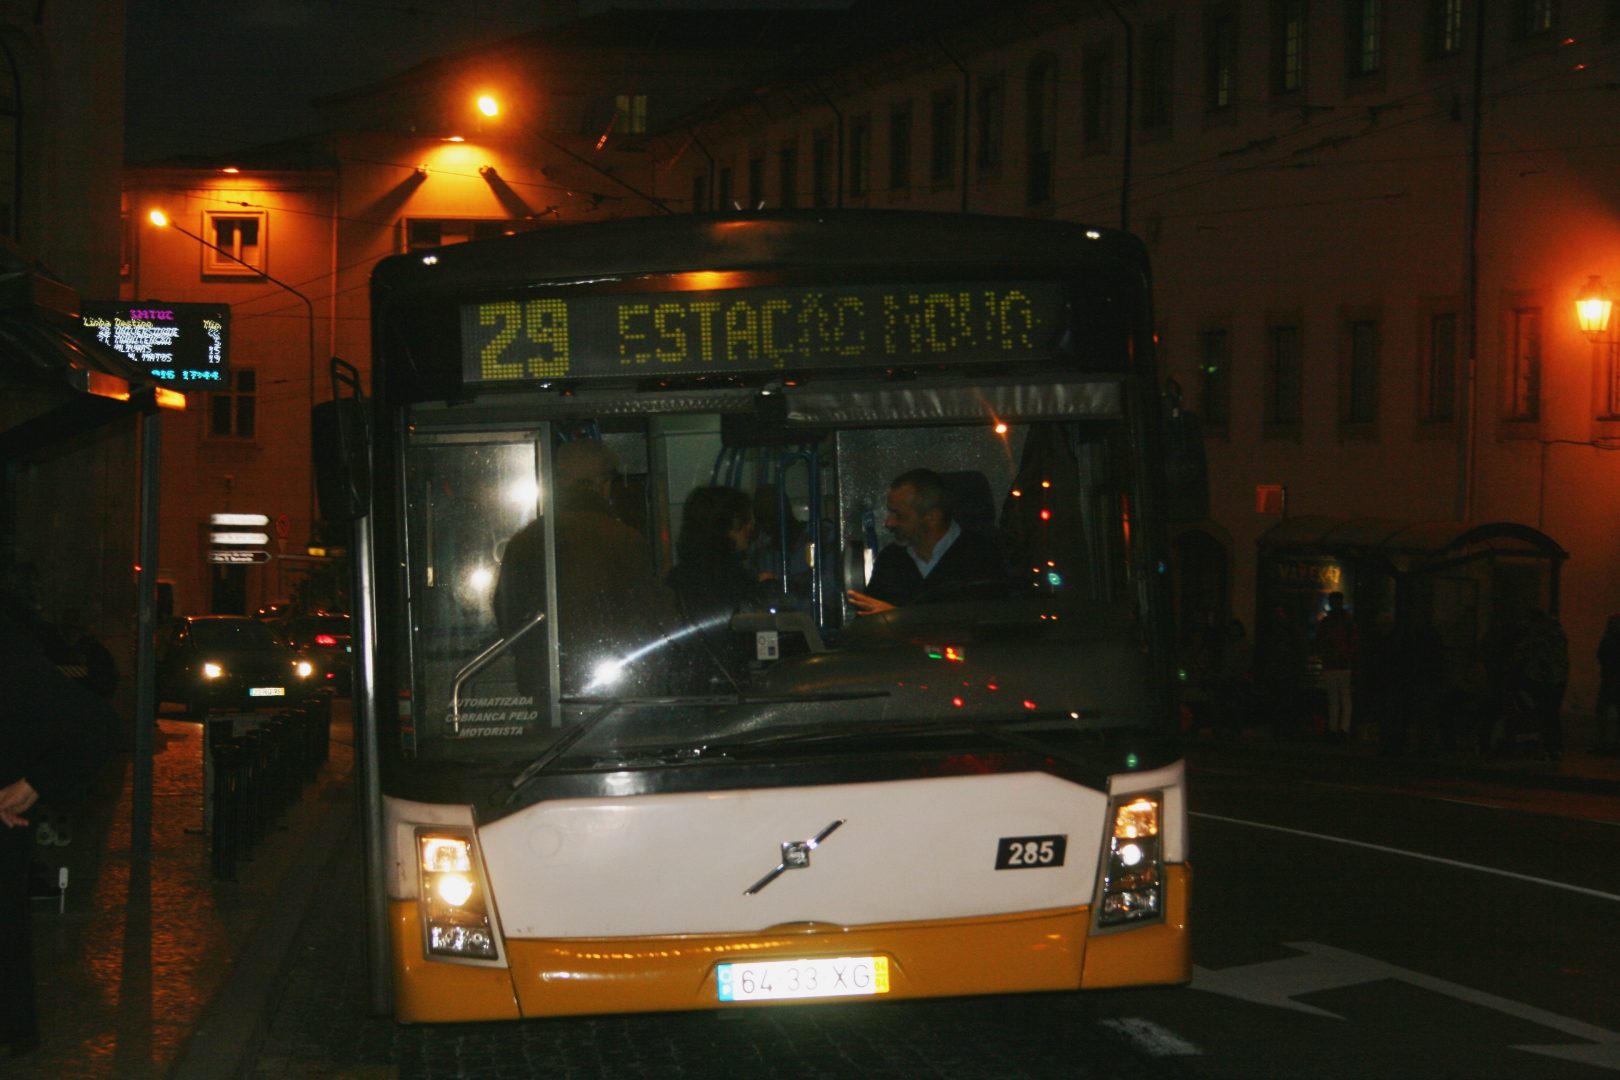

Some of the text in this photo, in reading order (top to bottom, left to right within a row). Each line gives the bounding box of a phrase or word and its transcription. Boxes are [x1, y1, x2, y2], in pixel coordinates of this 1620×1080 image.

[83, 317, 112, 328] Linha
[114, 317, 154, 329] Destino
[478, 297, 571, 380] 29
[508, 710, 539, 721] PELO
[459, 726, 524, 737] MOTORISTA
[1007, 840, 1055, 865] 285
